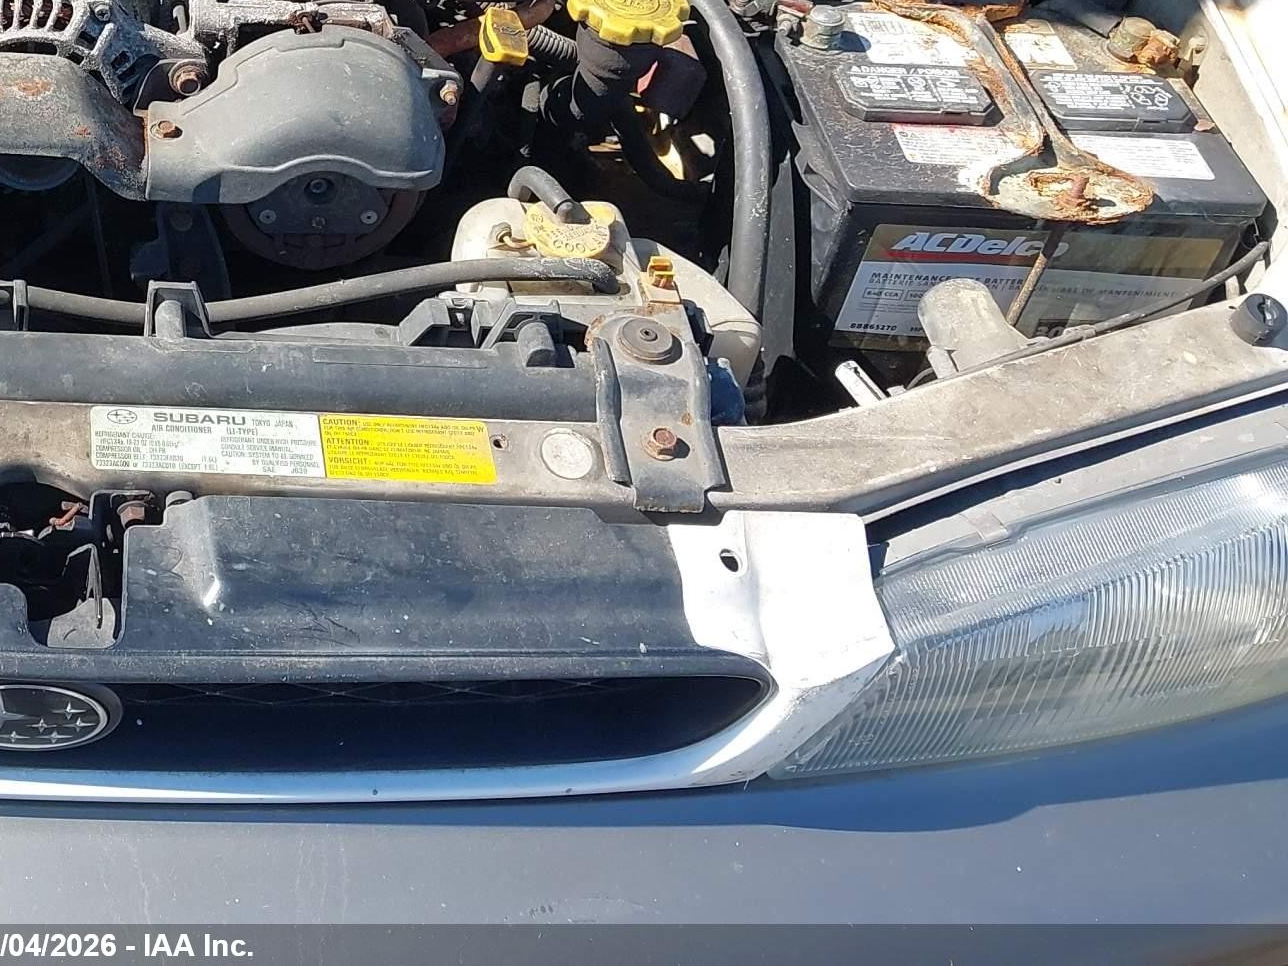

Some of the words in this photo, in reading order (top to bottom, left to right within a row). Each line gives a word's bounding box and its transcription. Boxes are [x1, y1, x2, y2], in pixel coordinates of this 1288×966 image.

[984, 277, 1025, 285] BATTER
[153, 412, 246, 425] SUBARU
[252, 418, 271, 426] TOKYO
[274, 419, 294, 427] JAPAN
[165, 425, 212, 433] CONDITIONER
